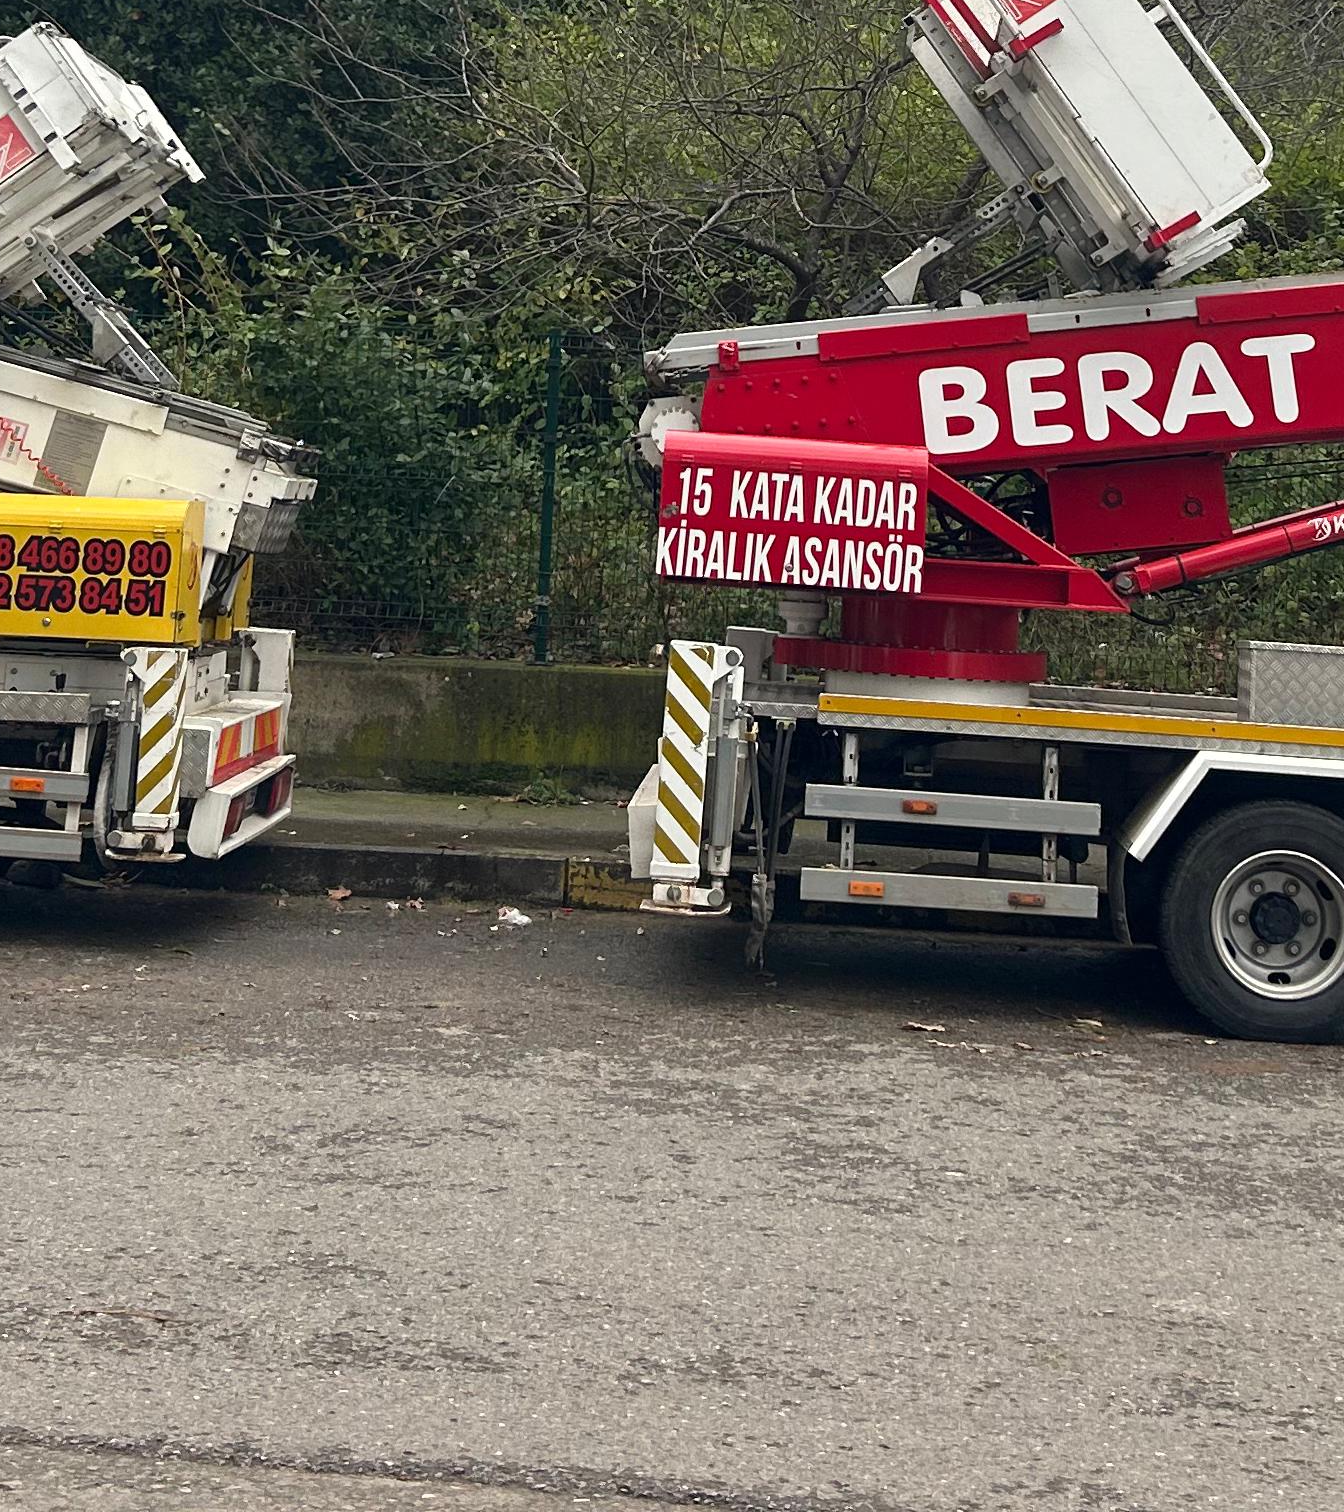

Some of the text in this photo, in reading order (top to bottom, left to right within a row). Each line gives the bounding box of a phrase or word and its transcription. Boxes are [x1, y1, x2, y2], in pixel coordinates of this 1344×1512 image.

[918, 333, 1316, 456] BERAT
[679, 467, 918, 531] 15 KATA KADAR
[20, 537, 78, 571] 466
[83, 540, 125, 574] 89
[130, 542, 169, 575] 80
[656, 519, 924, 594] KİRALIK ASANSÖR
[17, 575, 74, 610] 573
[80, 579, 120, 612] 84
[127, 581, 165, 615] 51
